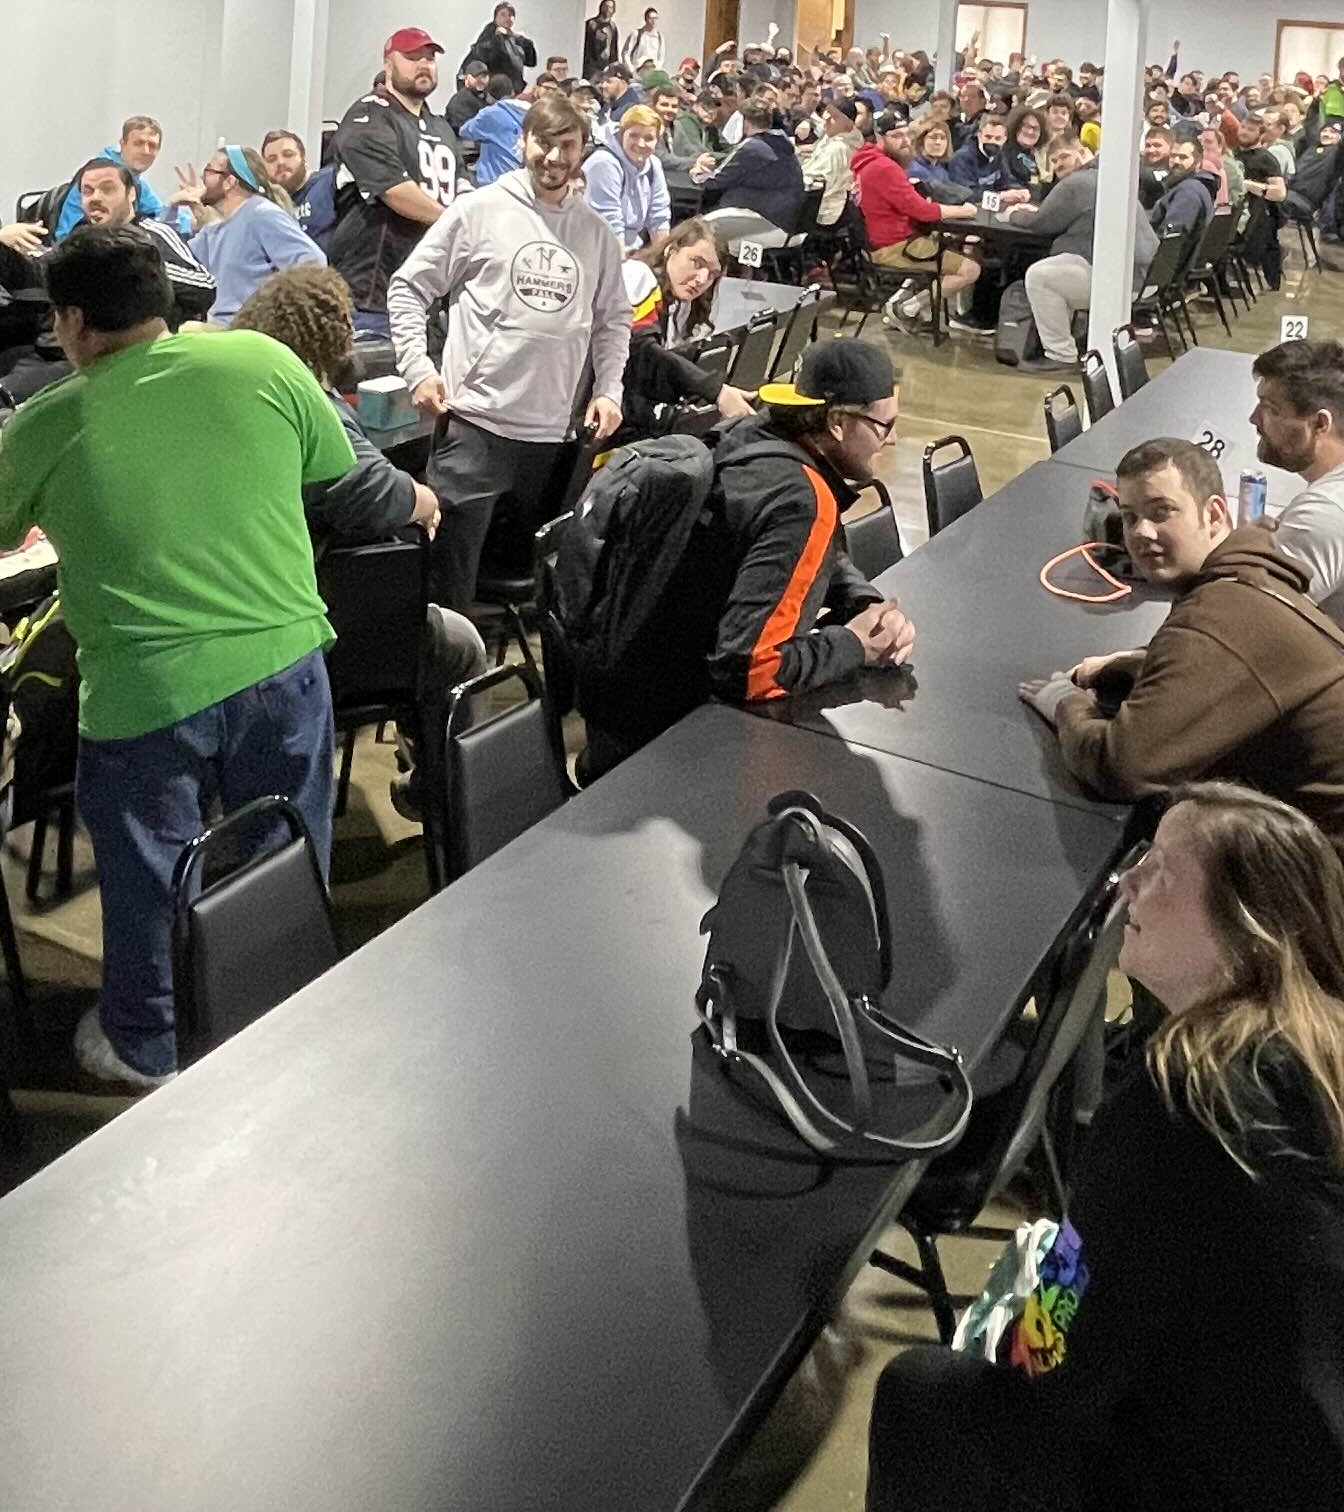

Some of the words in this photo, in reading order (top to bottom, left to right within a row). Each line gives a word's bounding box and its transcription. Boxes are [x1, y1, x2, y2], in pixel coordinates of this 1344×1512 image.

[417, 139, 456, 206] 99
[743, 245, 758, 262] 26
[516, 275, 572, 294] HAMMERS
[1286, 321, 1304, 338] 22
[1194, 430, 1225, 460] 28
